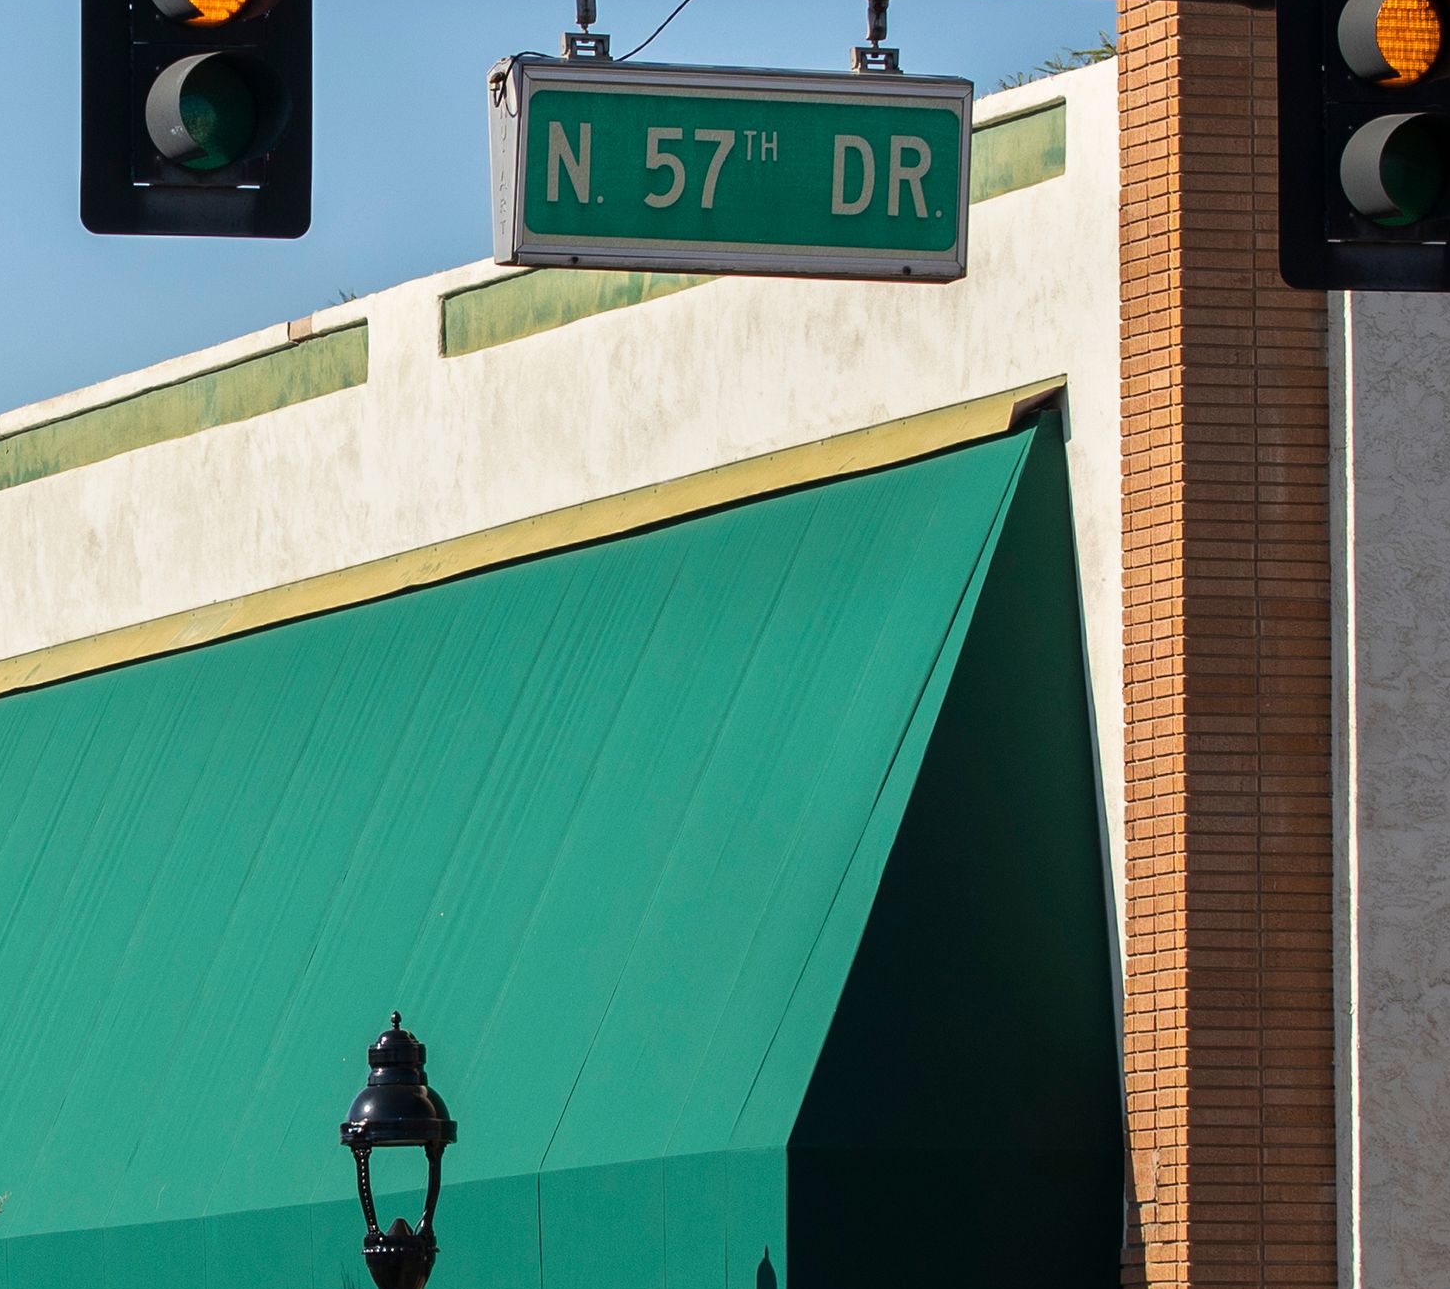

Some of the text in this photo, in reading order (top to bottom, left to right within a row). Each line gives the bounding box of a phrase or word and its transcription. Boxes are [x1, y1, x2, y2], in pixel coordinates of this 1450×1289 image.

[547, 121, 943, 218] N. 57TH DR.
